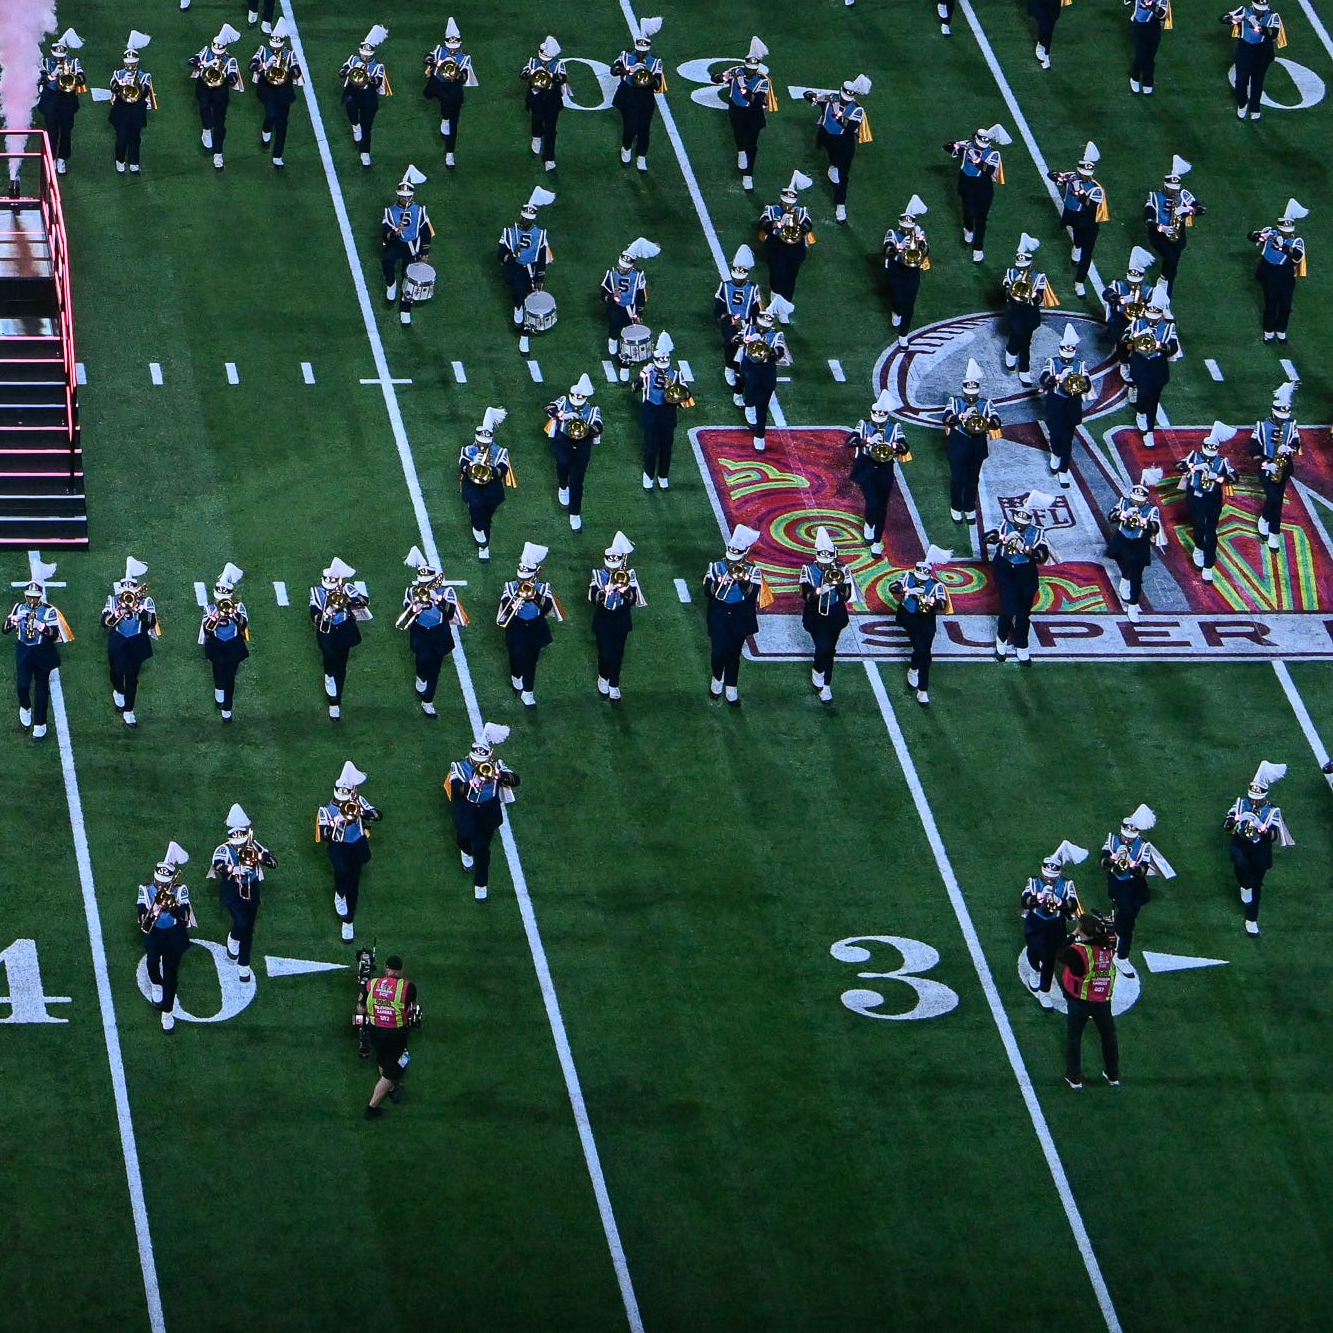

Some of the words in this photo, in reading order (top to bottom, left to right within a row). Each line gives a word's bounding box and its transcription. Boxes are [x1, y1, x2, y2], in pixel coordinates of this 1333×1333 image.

[400, 212, 412, 227] S
[520, 234, 532, 248] S
[619, 278, 631, 292] S
[733, 290, 745, 306] S
[859, 620, 1280, 649] SUPER
